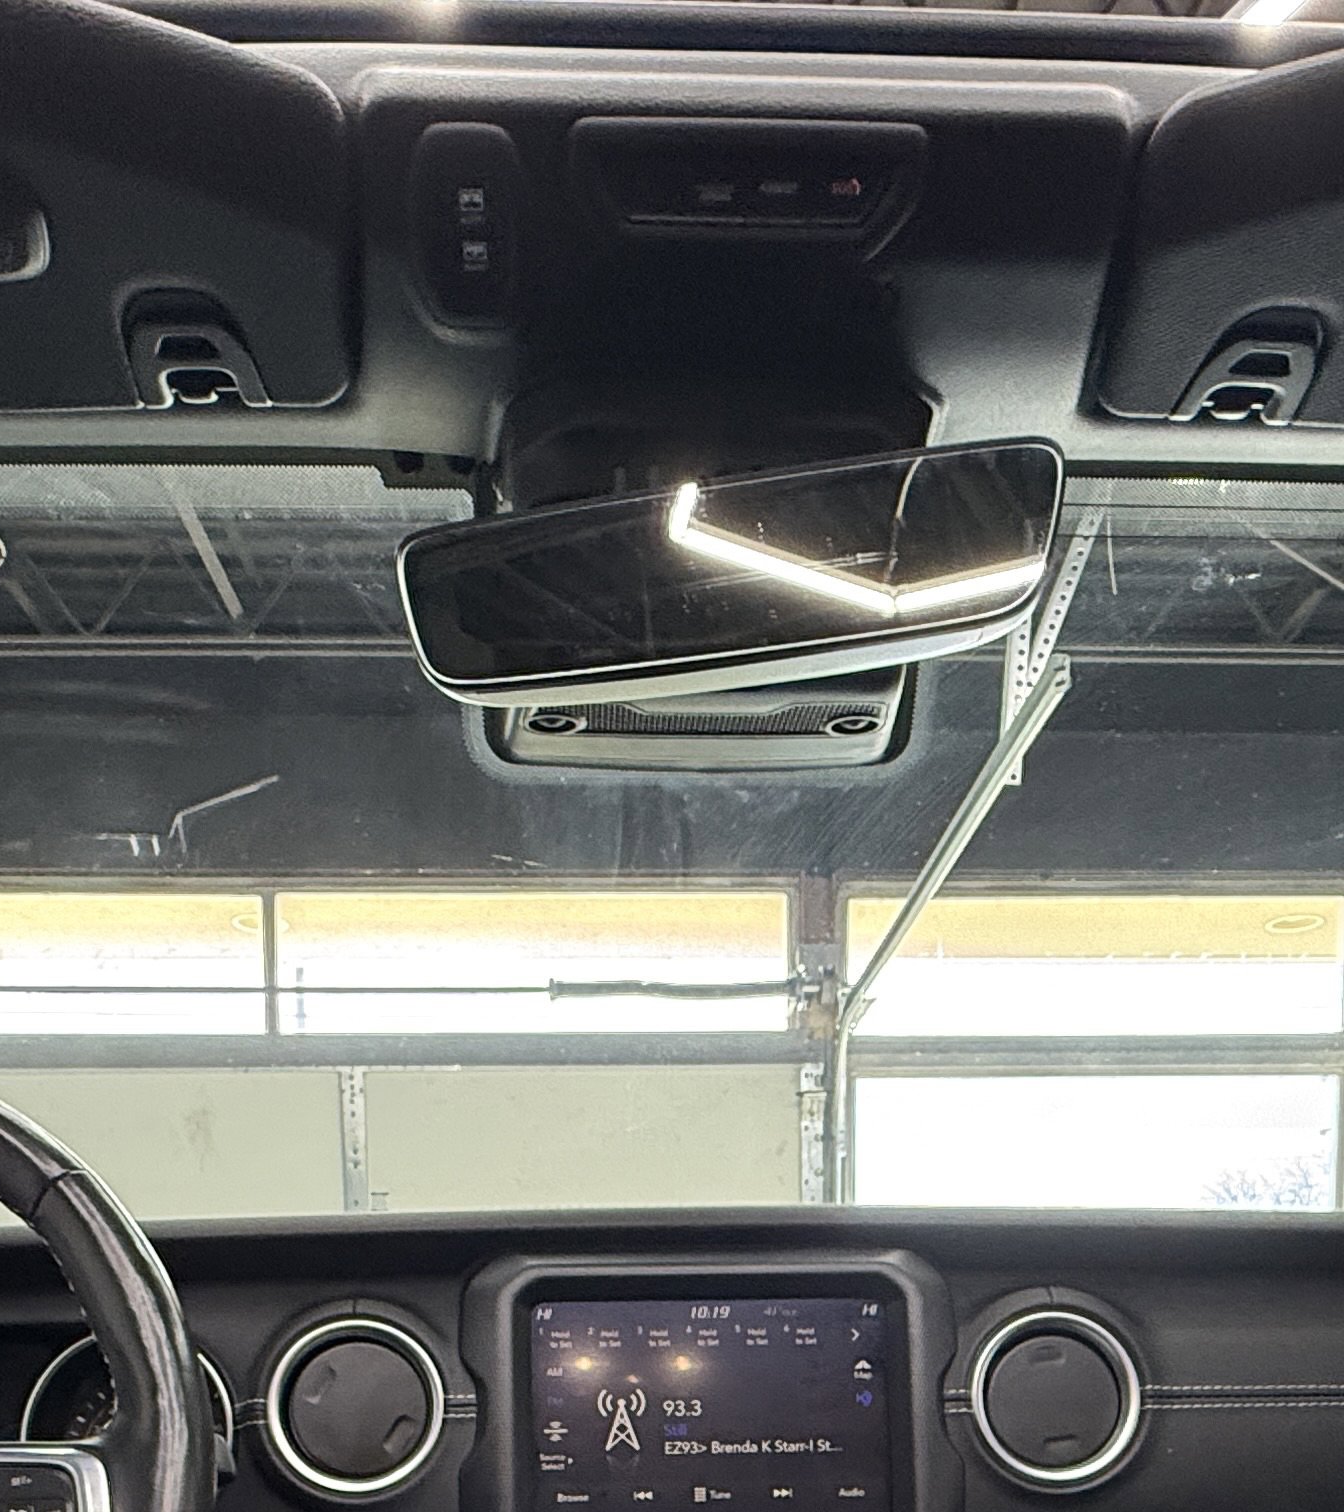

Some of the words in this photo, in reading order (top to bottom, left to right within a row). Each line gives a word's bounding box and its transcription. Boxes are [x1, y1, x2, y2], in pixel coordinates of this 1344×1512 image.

[691, 1305, 731, 1320] 10:19
[662, 1399, 703, 1417] 93.3
[664, 1440, 707, 1455] EZ93>
[711, 1439, 758, 1454] Brenda
[761, 1439, 773, 1453] K
[838, 1486, 866, 1498] Audio
